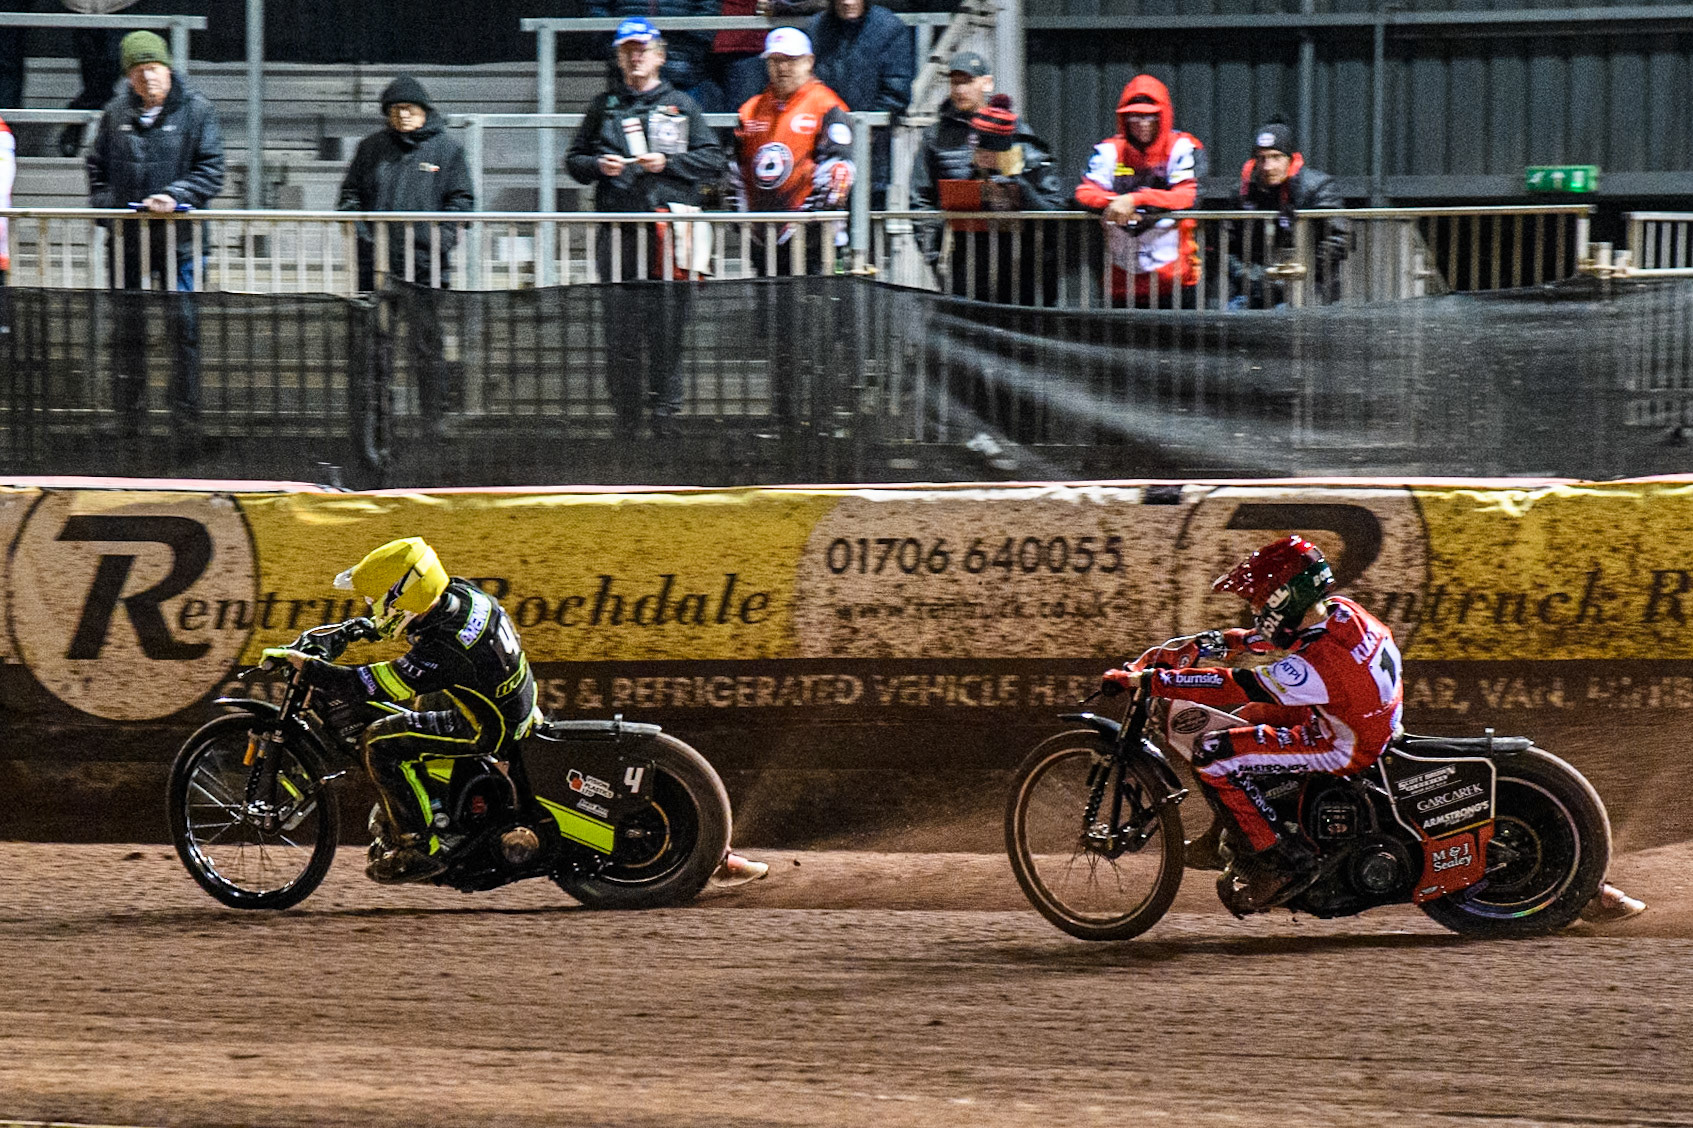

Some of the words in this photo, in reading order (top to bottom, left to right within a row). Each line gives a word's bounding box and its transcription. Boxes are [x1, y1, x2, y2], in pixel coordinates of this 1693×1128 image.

[828, 537, 948, 574] 01706
[964, 537, 1123, 574] 640055
[1175, 672, 1224, 685] burnside
[1279, 660, 1302, 681] ATPI
[584, 782, 614, 797] PLASTICS
[623, 767, 644, 793] 4
[1416, 783, 1484, 811] GARCAREK
[1423, 800, 1490, 829] ARMSTRONG'S
[1432, 850, 1446, 861] M
[1449, 846, 1461, 857] &
[1463, 843, 1469, 855] J
[1433, 855, 1472, 872] Sealey
